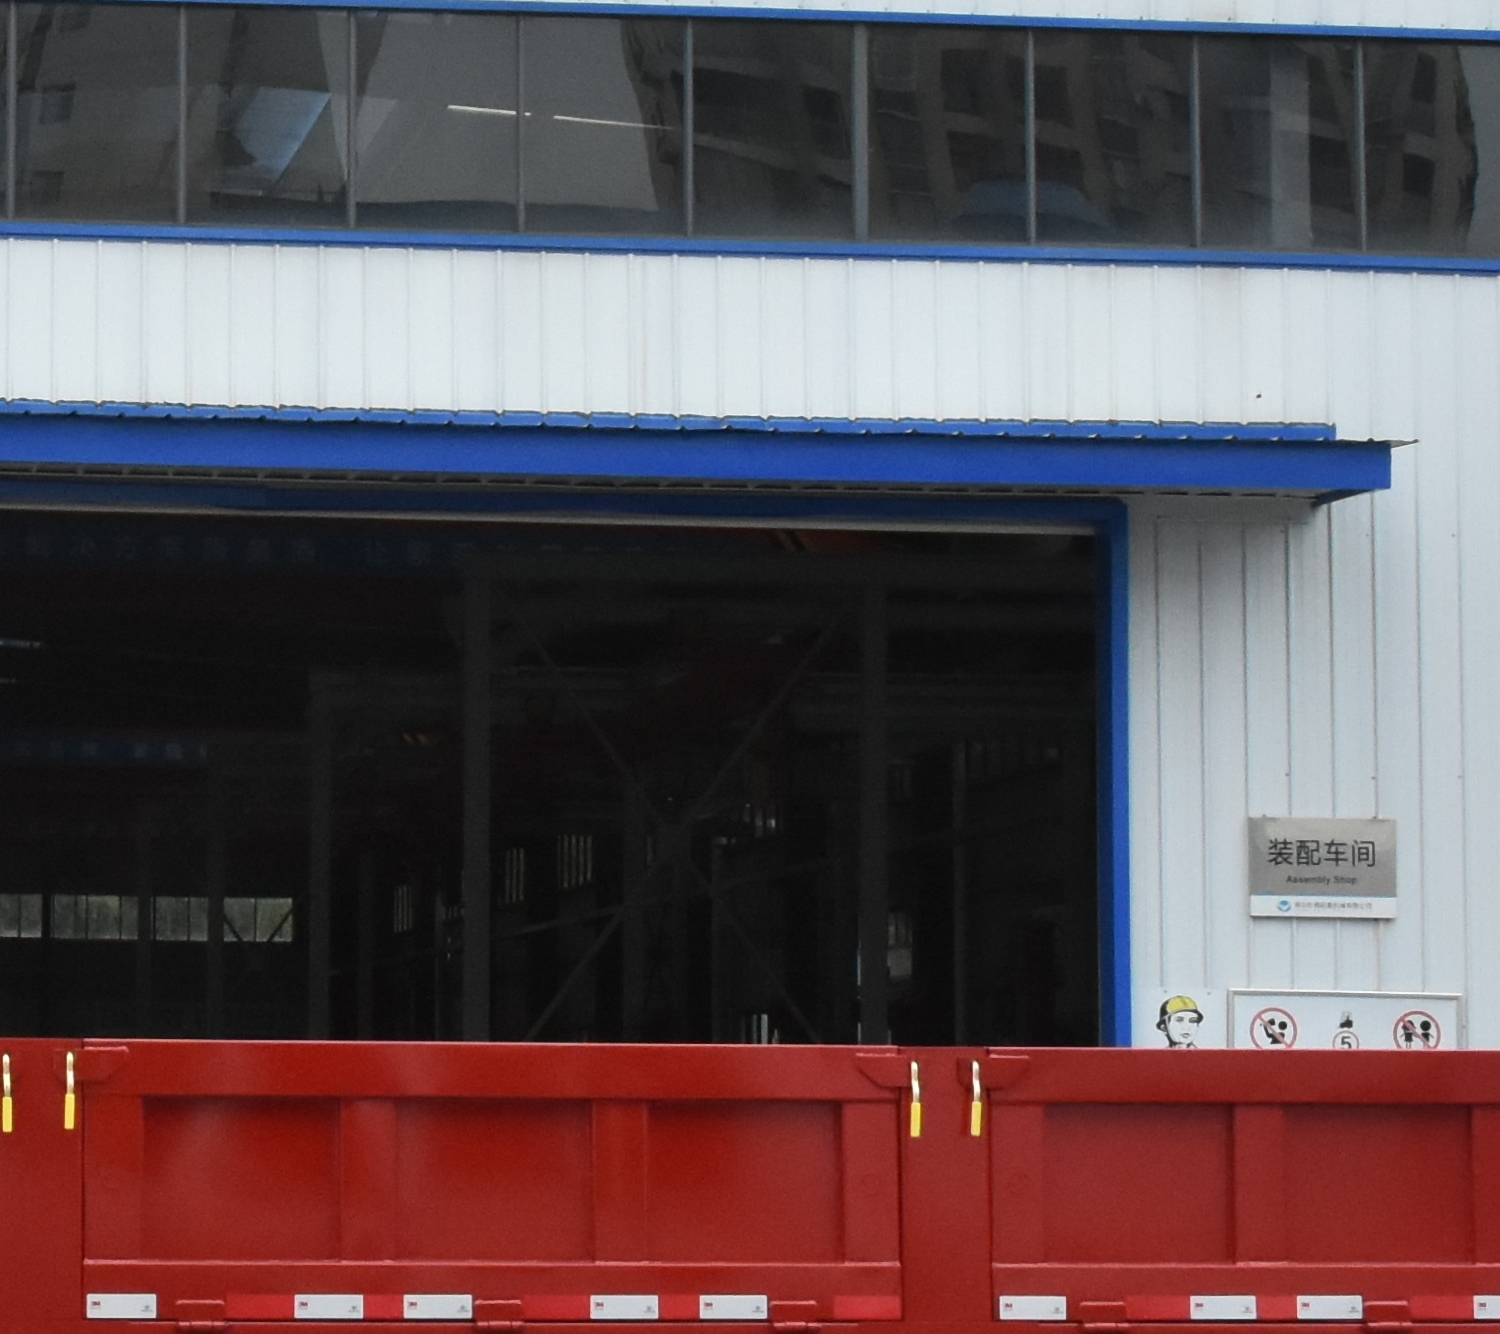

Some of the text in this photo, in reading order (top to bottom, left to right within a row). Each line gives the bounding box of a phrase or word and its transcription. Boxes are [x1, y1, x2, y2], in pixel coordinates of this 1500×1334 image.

[1268, 838, 1376, 868] 装配车间
[1286, 875, 1358, 885] Assembly Shop
